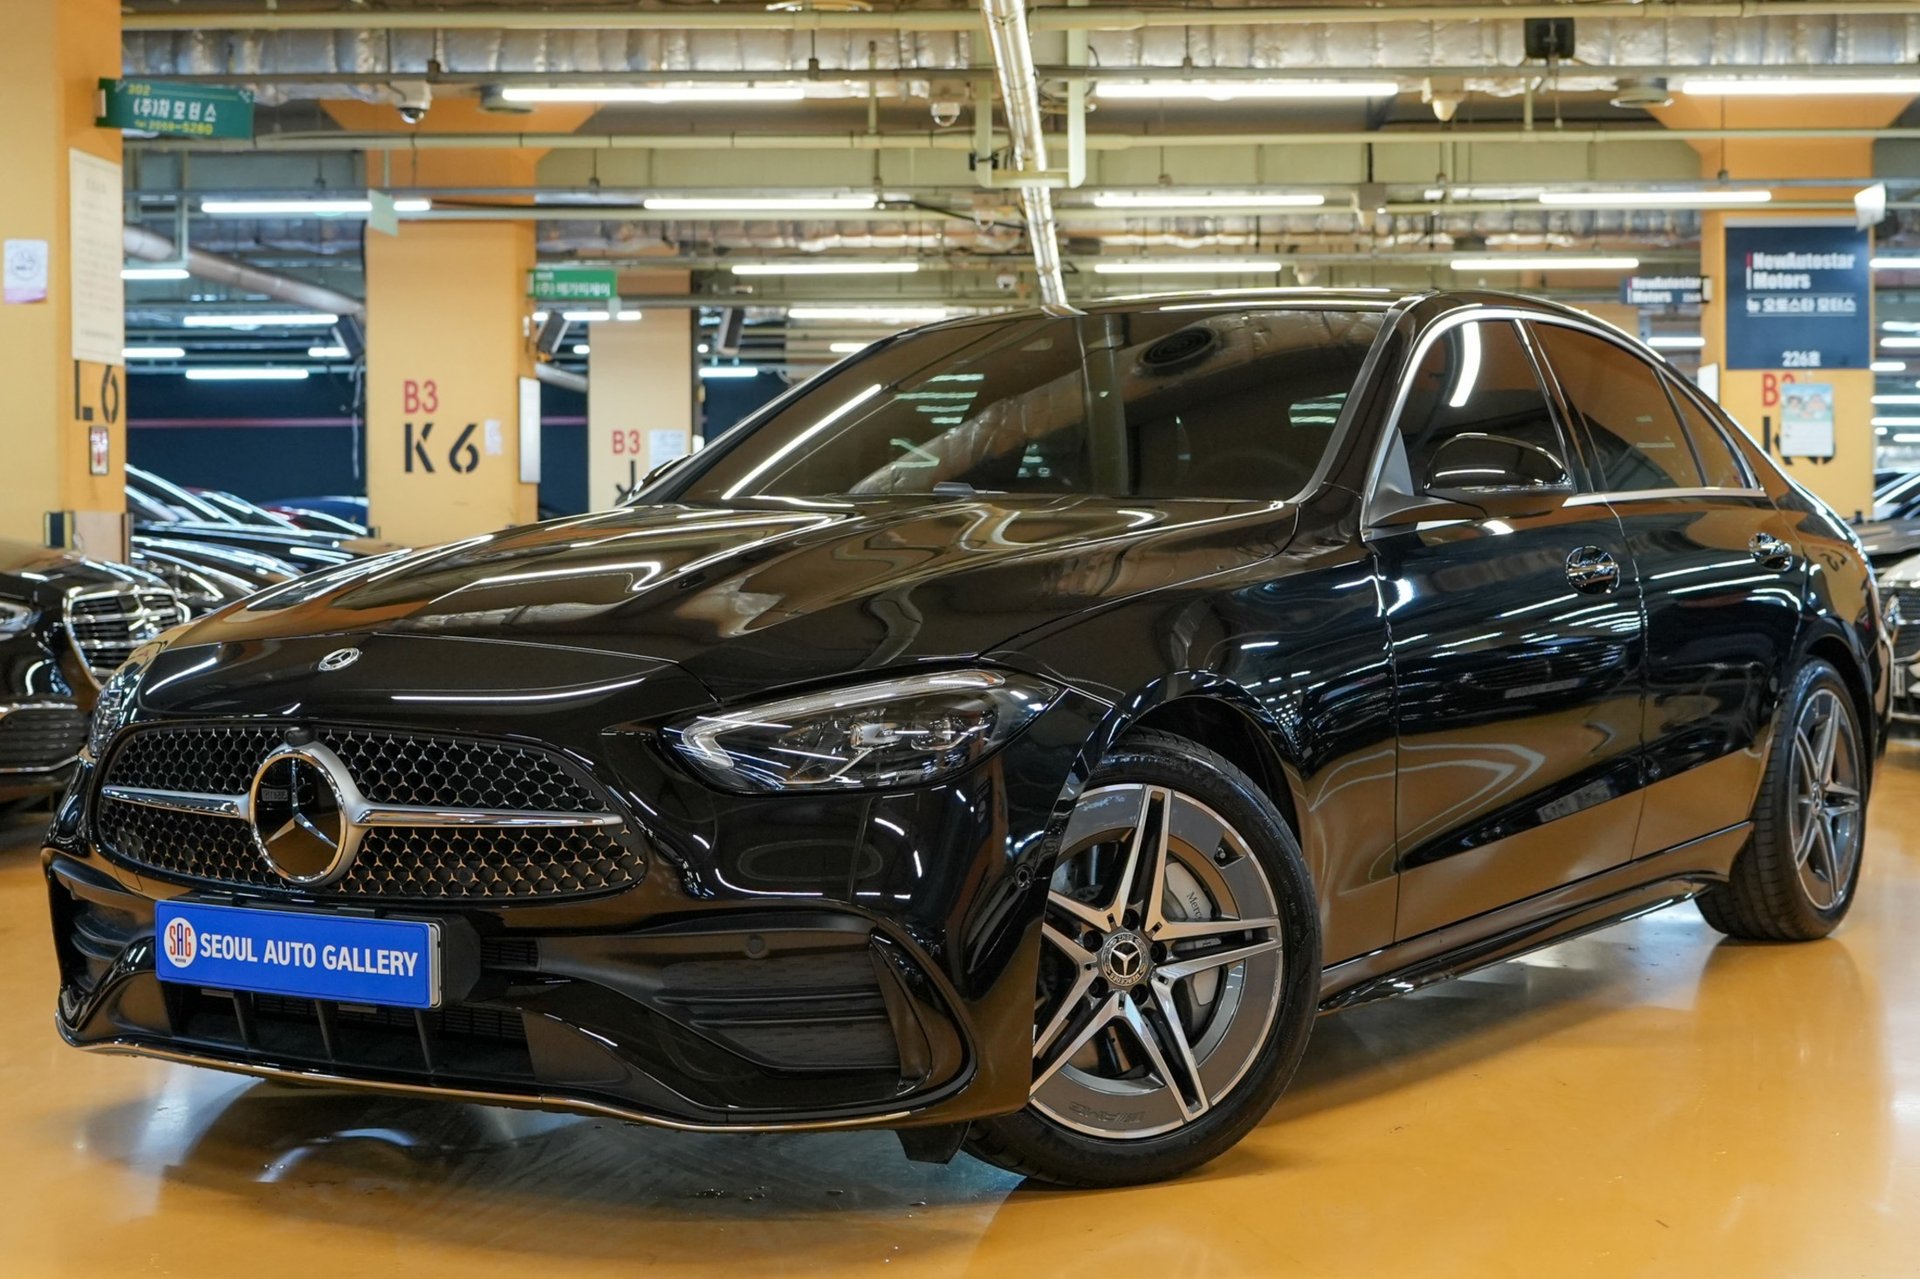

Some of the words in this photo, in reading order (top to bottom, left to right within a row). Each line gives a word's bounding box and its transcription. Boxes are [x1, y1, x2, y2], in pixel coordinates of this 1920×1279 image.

[1753, 272, 1811, 290] Motors
[404, 380, 439, 414] B3
[612, 429, 640, 455] B3
[169, 922, 192, 957] SAG
[200, 932, 258, 964] SEOUL
[263, 940, 317, 969] AUTO
[322, 945, 419, 977] GALLERY
